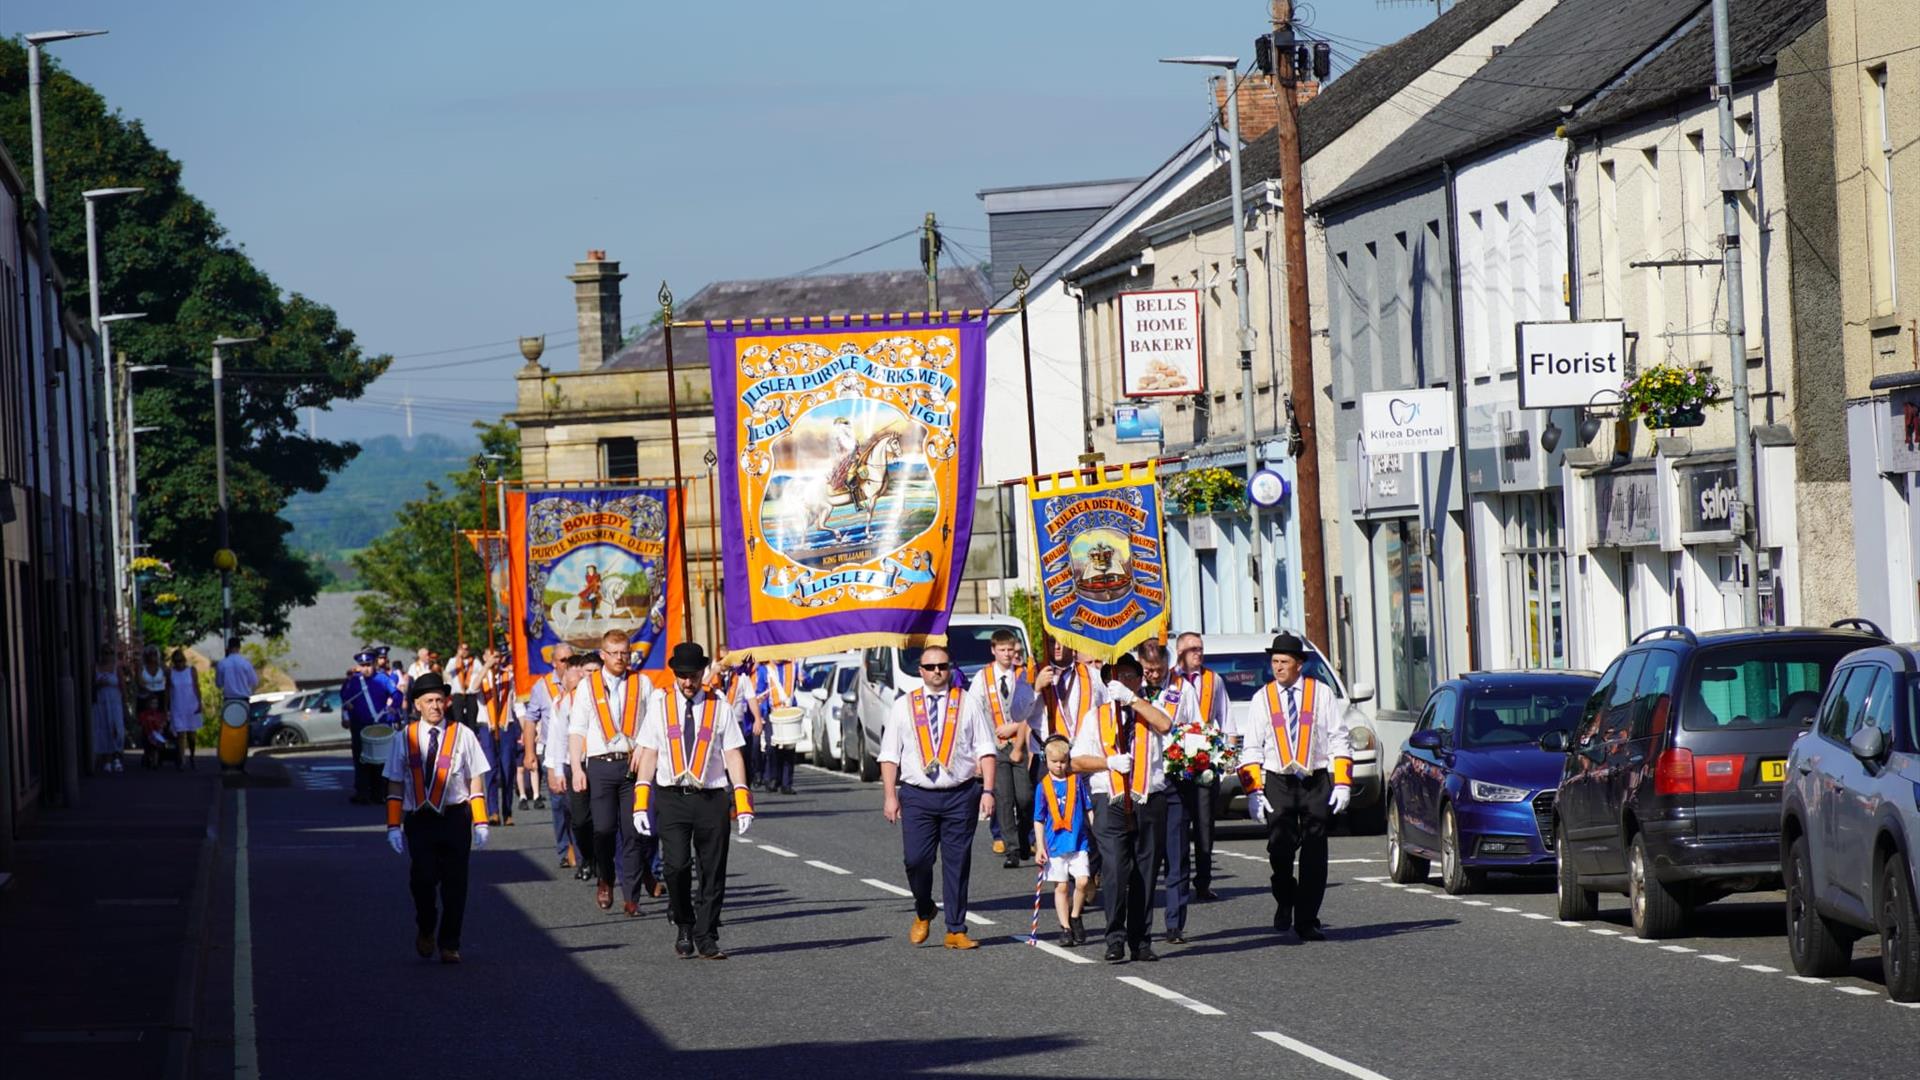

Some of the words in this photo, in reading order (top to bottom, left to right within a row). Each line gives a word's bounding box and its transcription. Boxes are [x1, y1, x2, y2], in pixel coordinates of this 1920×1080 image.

[1135, 297, 1187, 313] BELLS
[1136, 317, 1188, 333] HOME
[1130, 337, 1194, 353] BAKERY
[1530, 351, 1617, 376] Florist
[747, 377, 796, 402] LISLEA
[802, 354, 859, 389] PURPLE
[863, 361, 947, 389] MRKSMEN
[916, 407, 942, 426] 161
[1370, 428, 1402, 440] Kilrea
[1406, 425, 1443, 438] Dental
[1054, 502, 1090, 528] KILREA
[1092, 499, 1114, 510] DIST
[563, 514, 628, 533] BOVEEDY
[531, 542, 566, 559] PURPLE
[567, 529, 615, 547] MARKSMEN
